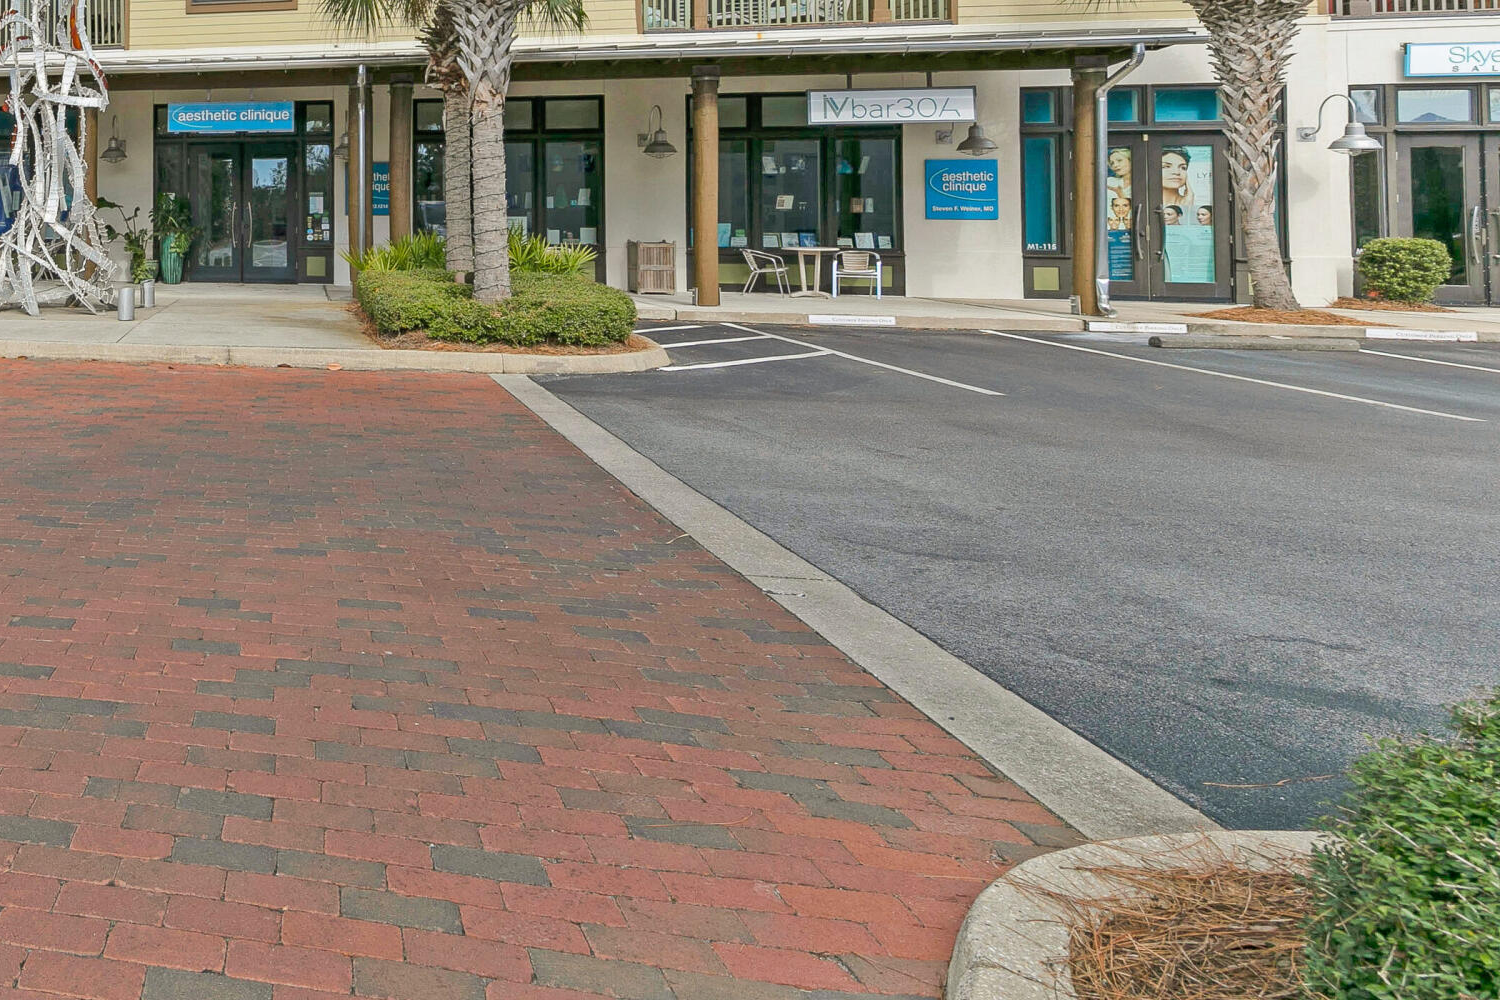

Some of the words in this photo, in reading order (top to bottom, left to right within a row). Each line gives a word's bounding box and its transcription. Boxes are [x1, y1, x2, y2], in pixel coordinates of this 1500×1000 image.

[178, 109, 237, 122] aesthetic
[239, 109, 290, 123] clinique
[942, 170, 994, 182] aesthetic
[942, 181, 987, 194] clinique
